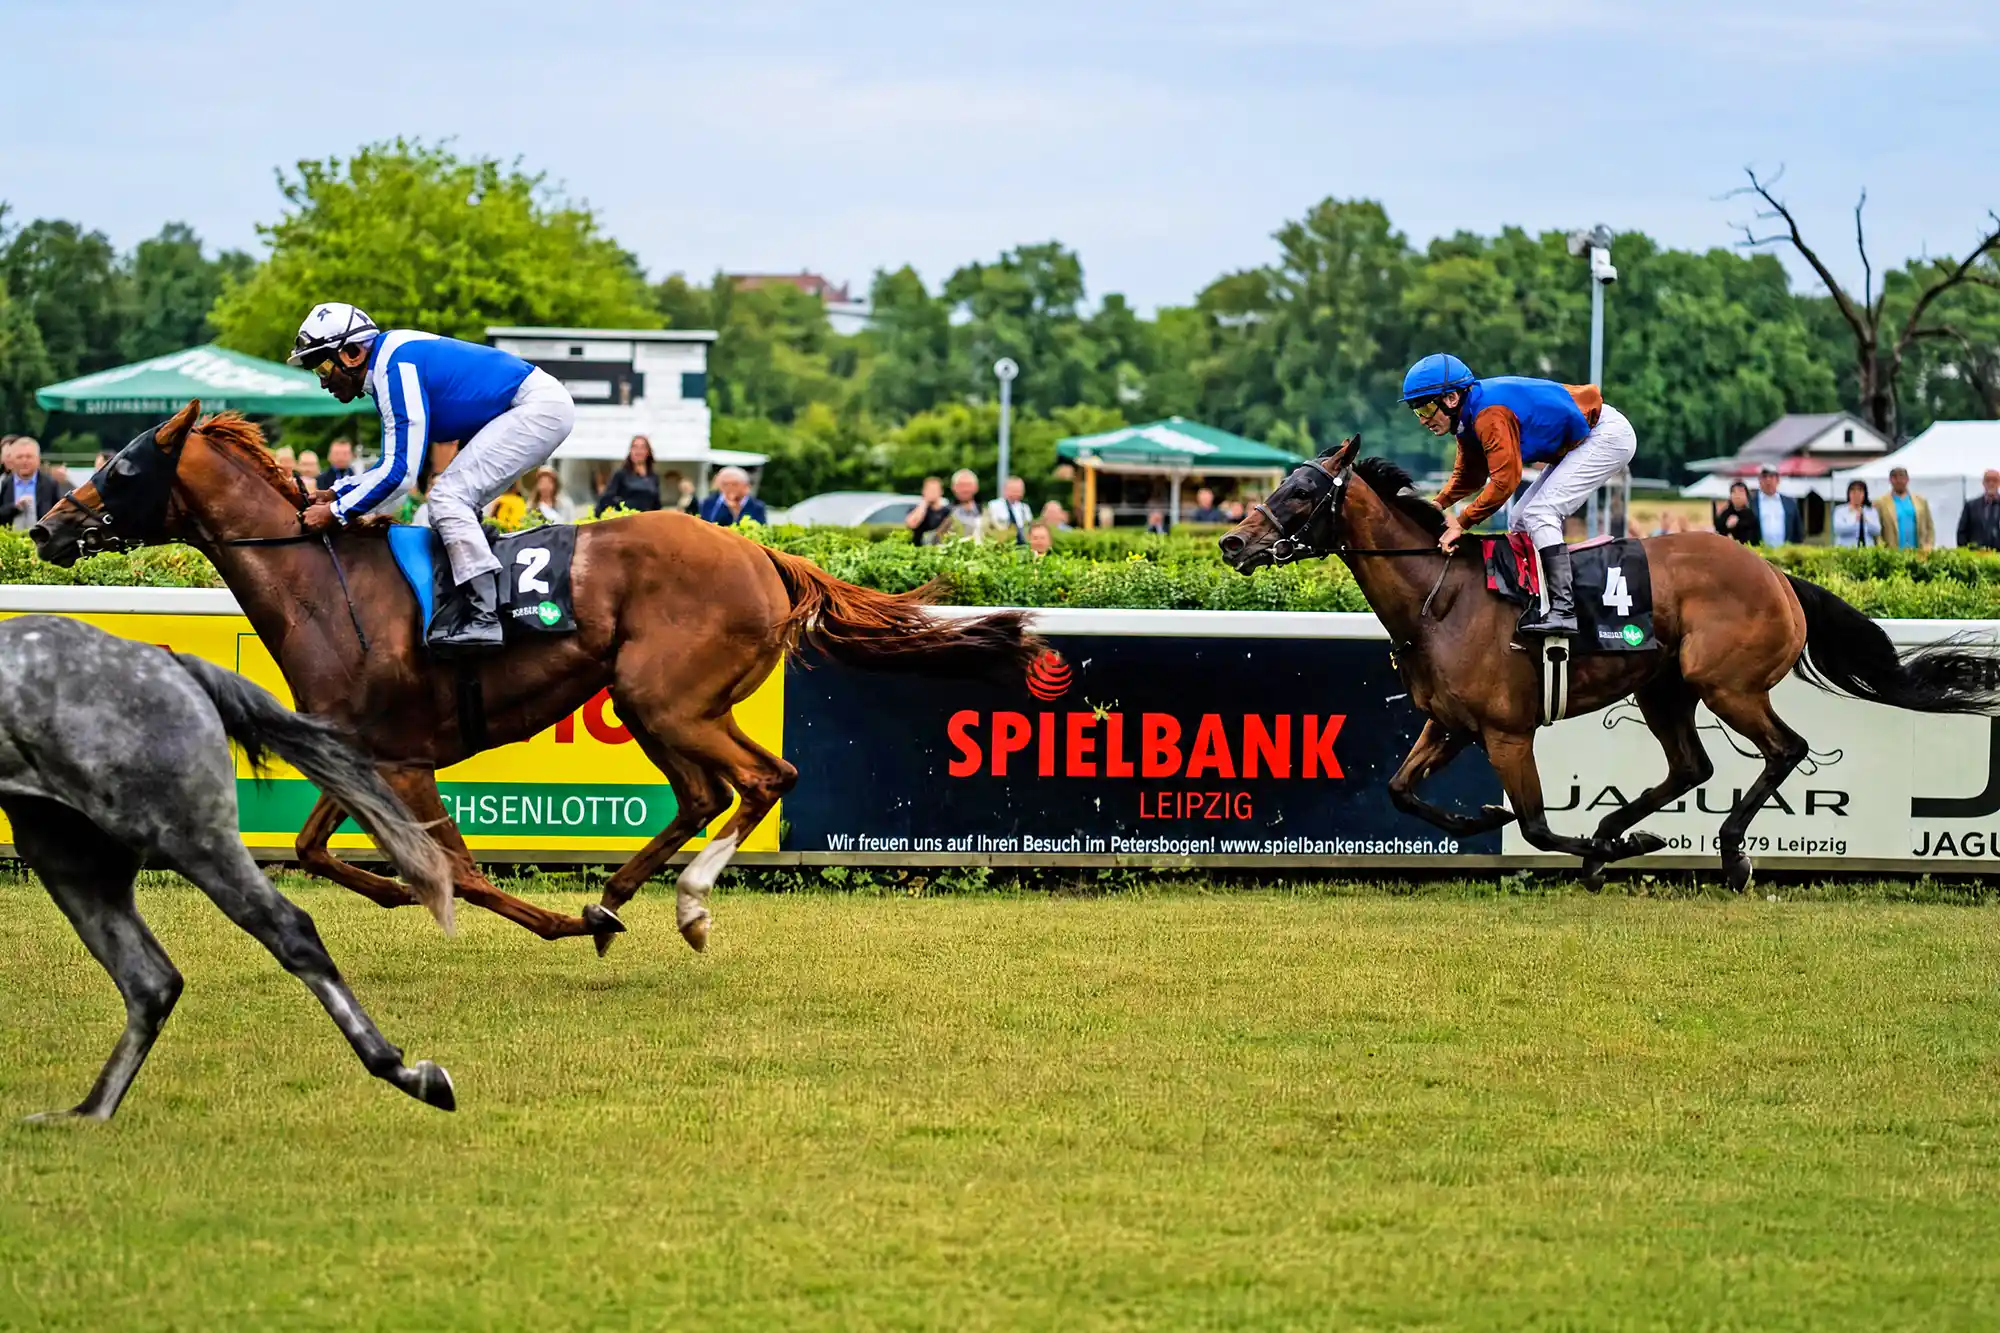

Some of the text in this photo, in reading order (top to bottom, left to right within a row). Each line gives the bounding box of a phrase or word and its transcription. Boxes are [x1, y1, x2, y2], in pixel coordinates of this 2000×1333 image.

[516, 547, 551, 594] 2
[1602, 566, 1633, 616] 4
[947, 709, 1347, 779] SPIELBANK
[1139, 791, 1253, 820] LEIPZIG
[826, 833, 1459, 857] Wir freuen uns auf Ihren Besuch im Petersbogen! www.spielbankensachsen.de
[1777, 836, 1847, 854] Leipzig
